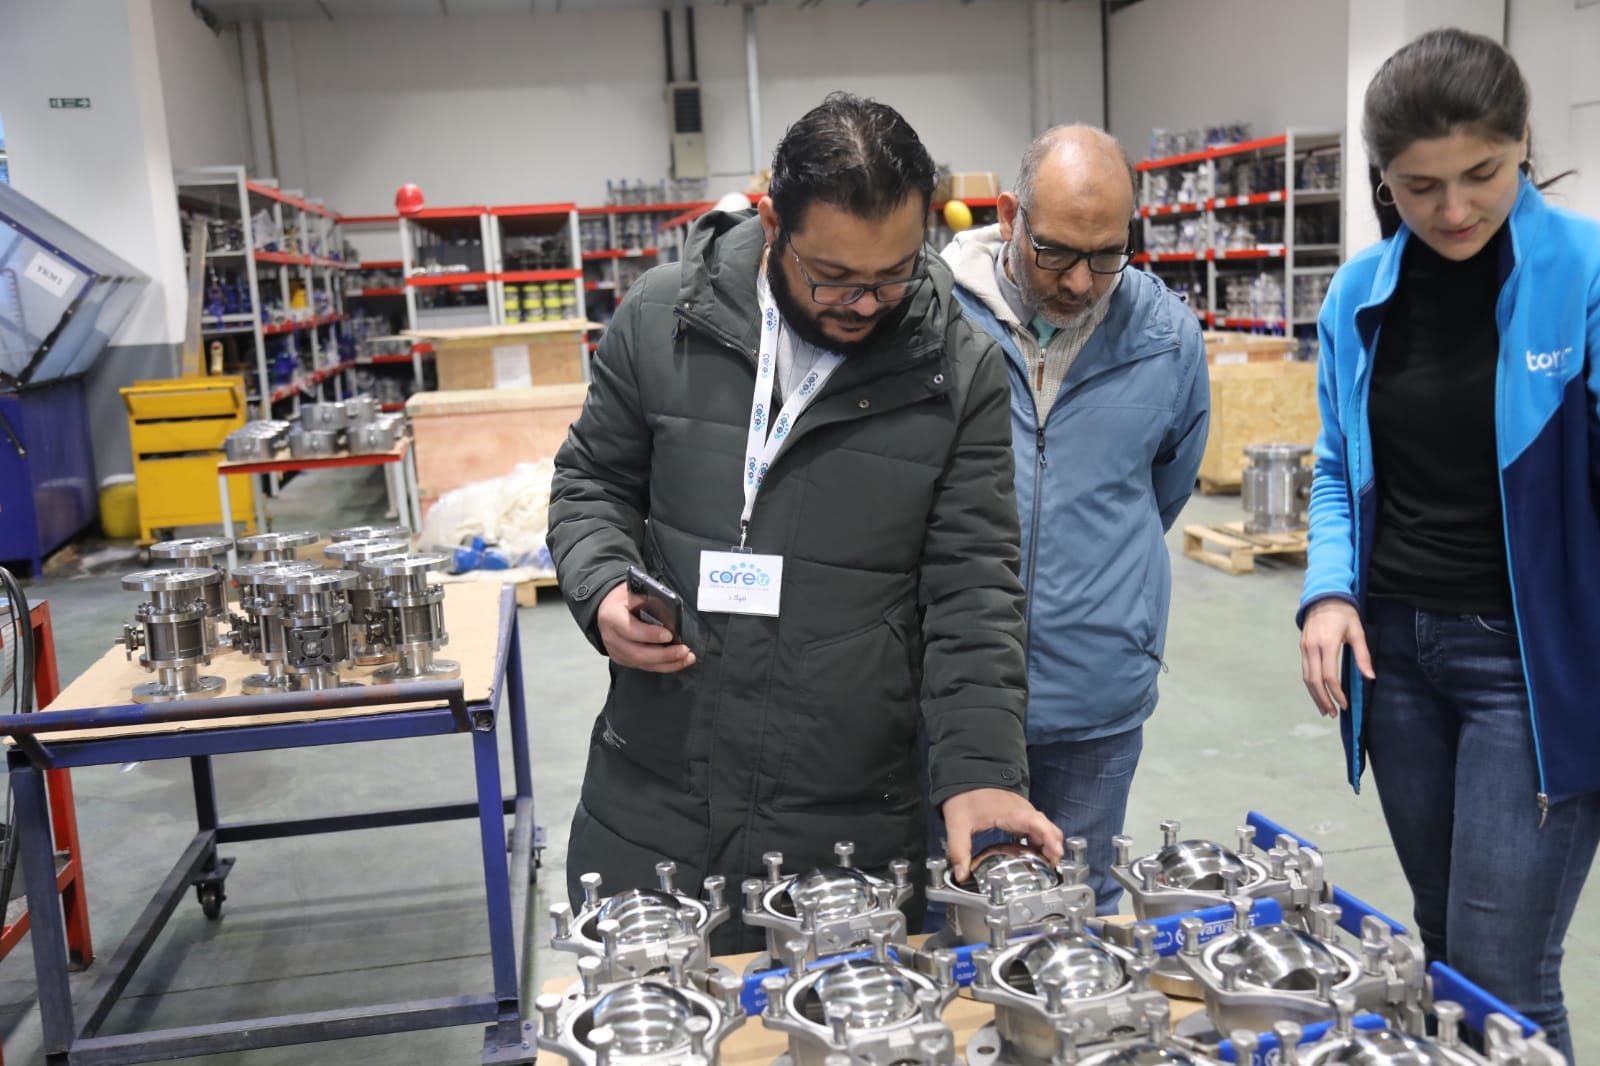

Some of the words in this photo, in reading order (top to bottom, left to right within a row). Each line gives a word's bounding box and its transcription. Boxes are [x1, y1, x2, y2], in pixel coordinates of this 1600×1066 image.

[802, 372, 819, 391] core
[754, 402, 764, 425] core
[776, 413, 790, 433] core
[709, 570, 756, 586] core
